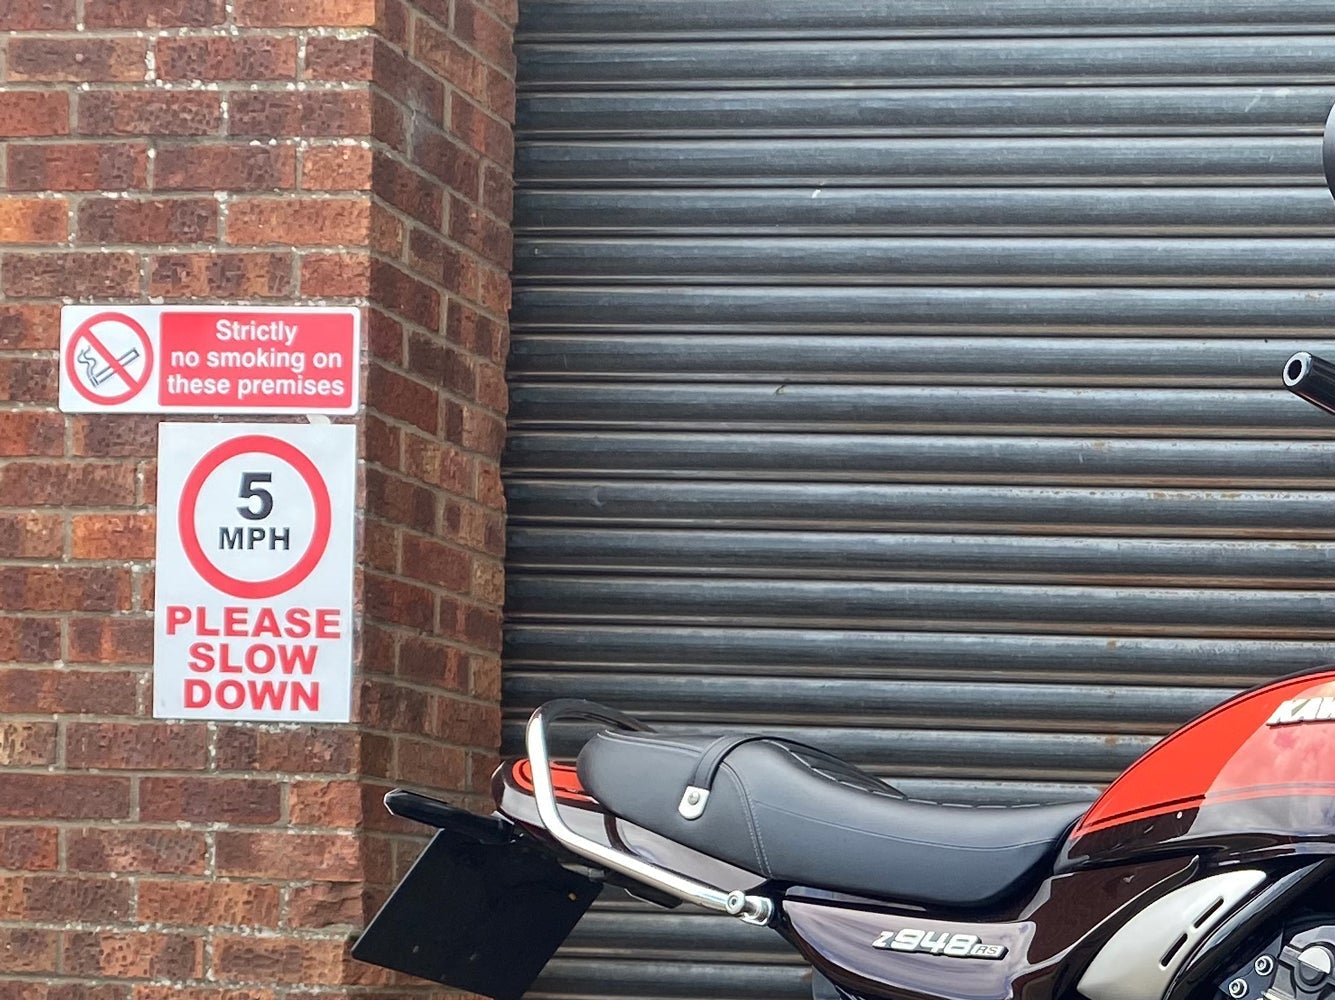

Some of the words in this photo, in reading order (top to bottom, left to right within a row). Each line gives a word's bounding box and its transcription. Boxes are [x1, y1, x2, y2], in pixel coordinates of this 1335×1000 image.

[216, 318, 298, 346] Strictly
[171, 350, 199, 367] no
[206, 347, 306, 372] smoking
[312, 351, 342, 368] on
[167, 374, 230, 394] these
[237, 374, 345, 399] premises
[236, 471, 274, 520] 5
[218, 526, 291, 551] MPH
[166, 605, 342, 639] PLEASE
[188, 643, 319, 675] SLOW
[183, 679, 320, 712] DOWN
